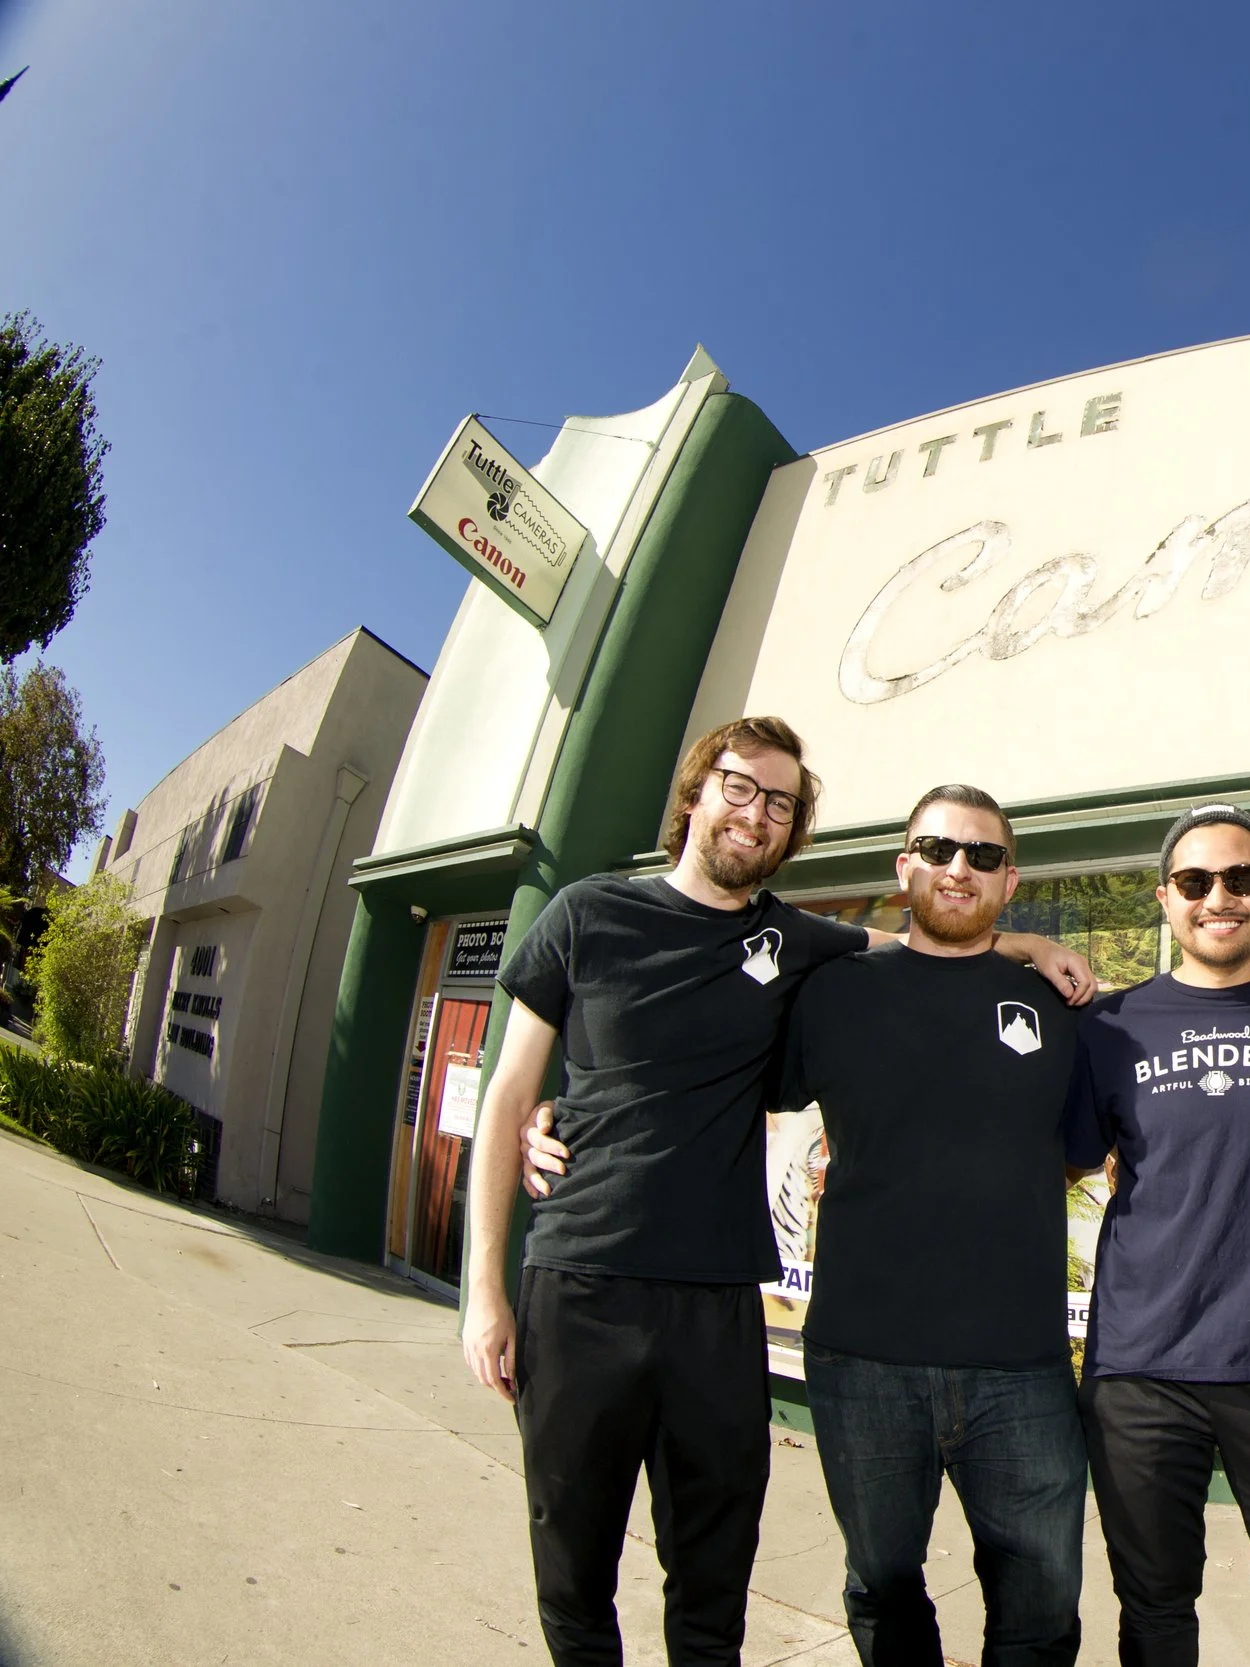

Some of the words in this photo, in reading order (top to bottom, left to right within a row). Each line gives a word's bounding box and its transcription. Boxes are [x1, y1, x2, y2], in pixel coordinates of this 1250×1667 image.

[466, 438, 515, 495] Tuttle
[823, 391, 1123, 508] TUTTLE
[457, 517, 527, 590] Canon
[513, 502, 559, 555] CAMERAS
[455, 950, 467, 967] Get
[466, 954, 480, 966] your
[478, 949, 499, 965] photos
[457, 932, 488, 948] PHOTO
[490, 931, 504, 946] BO
[1151, 1080, 1194, 1095] ARTFUL
